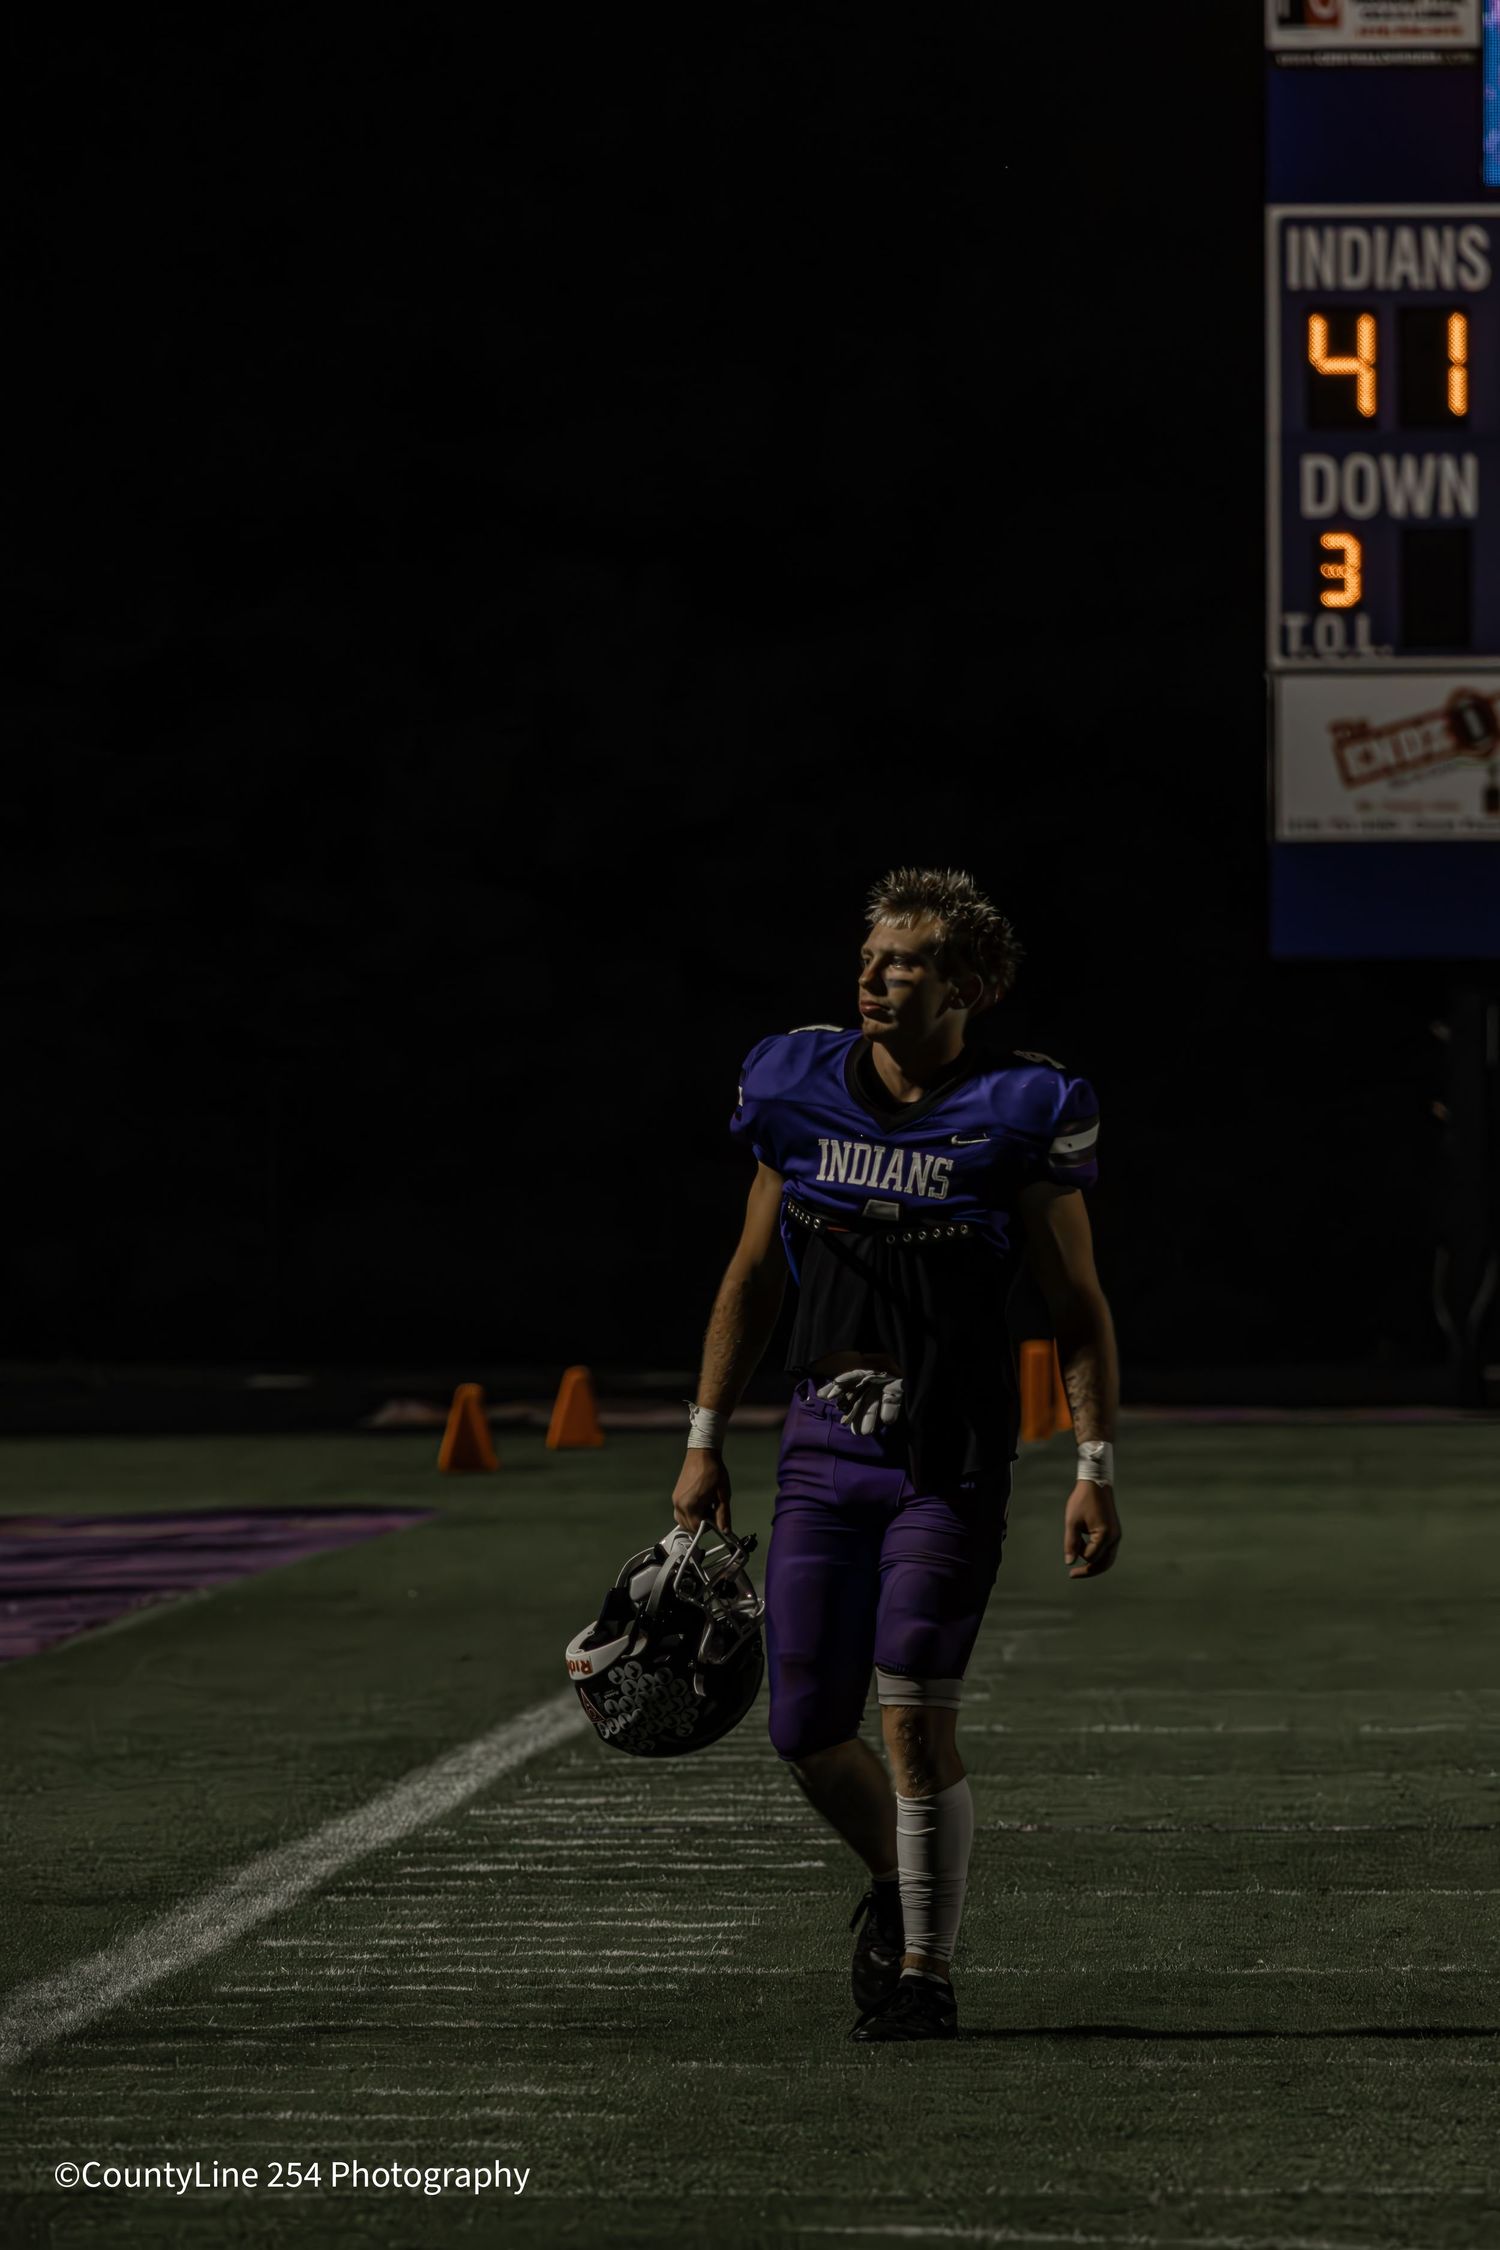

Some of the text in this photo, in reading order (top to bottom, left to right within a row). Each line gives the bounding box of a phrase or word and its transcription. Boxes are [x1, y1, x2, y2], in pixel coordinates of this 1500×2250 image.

[1286, 225, 1492, 292] INDIANS
[1300, 452, 1479, 520] DOWN
[1319, 531, 1362, 609] 3
[816, 1138, 954, 1200] INDIANS
